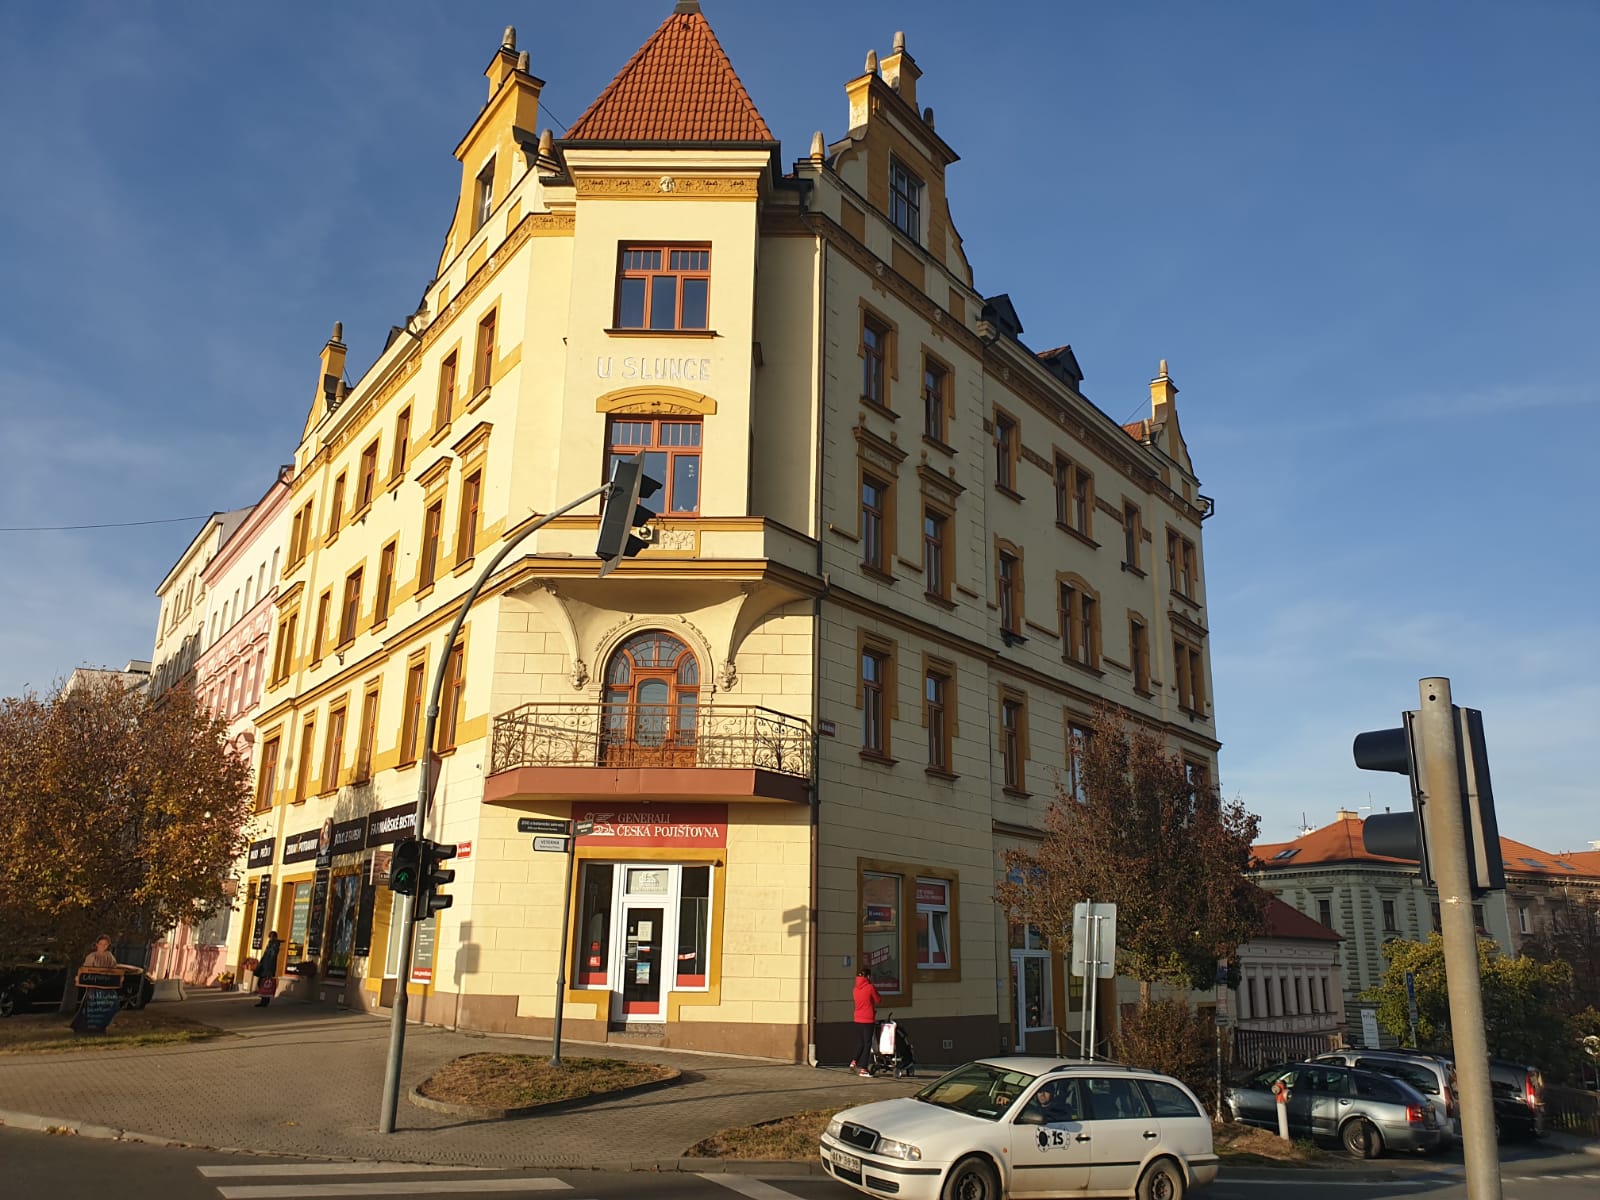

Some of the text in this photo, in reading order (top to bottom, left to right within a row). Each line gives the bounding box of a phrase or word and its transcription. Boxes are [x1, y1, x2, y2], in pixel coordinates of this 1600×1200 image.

[597, 357, 711, 381] U SLUNCE
[617, 813, 671, 823] GENERALI
[616, 824, 719, 838] ČESKÁ POJIŠŤOVNA
